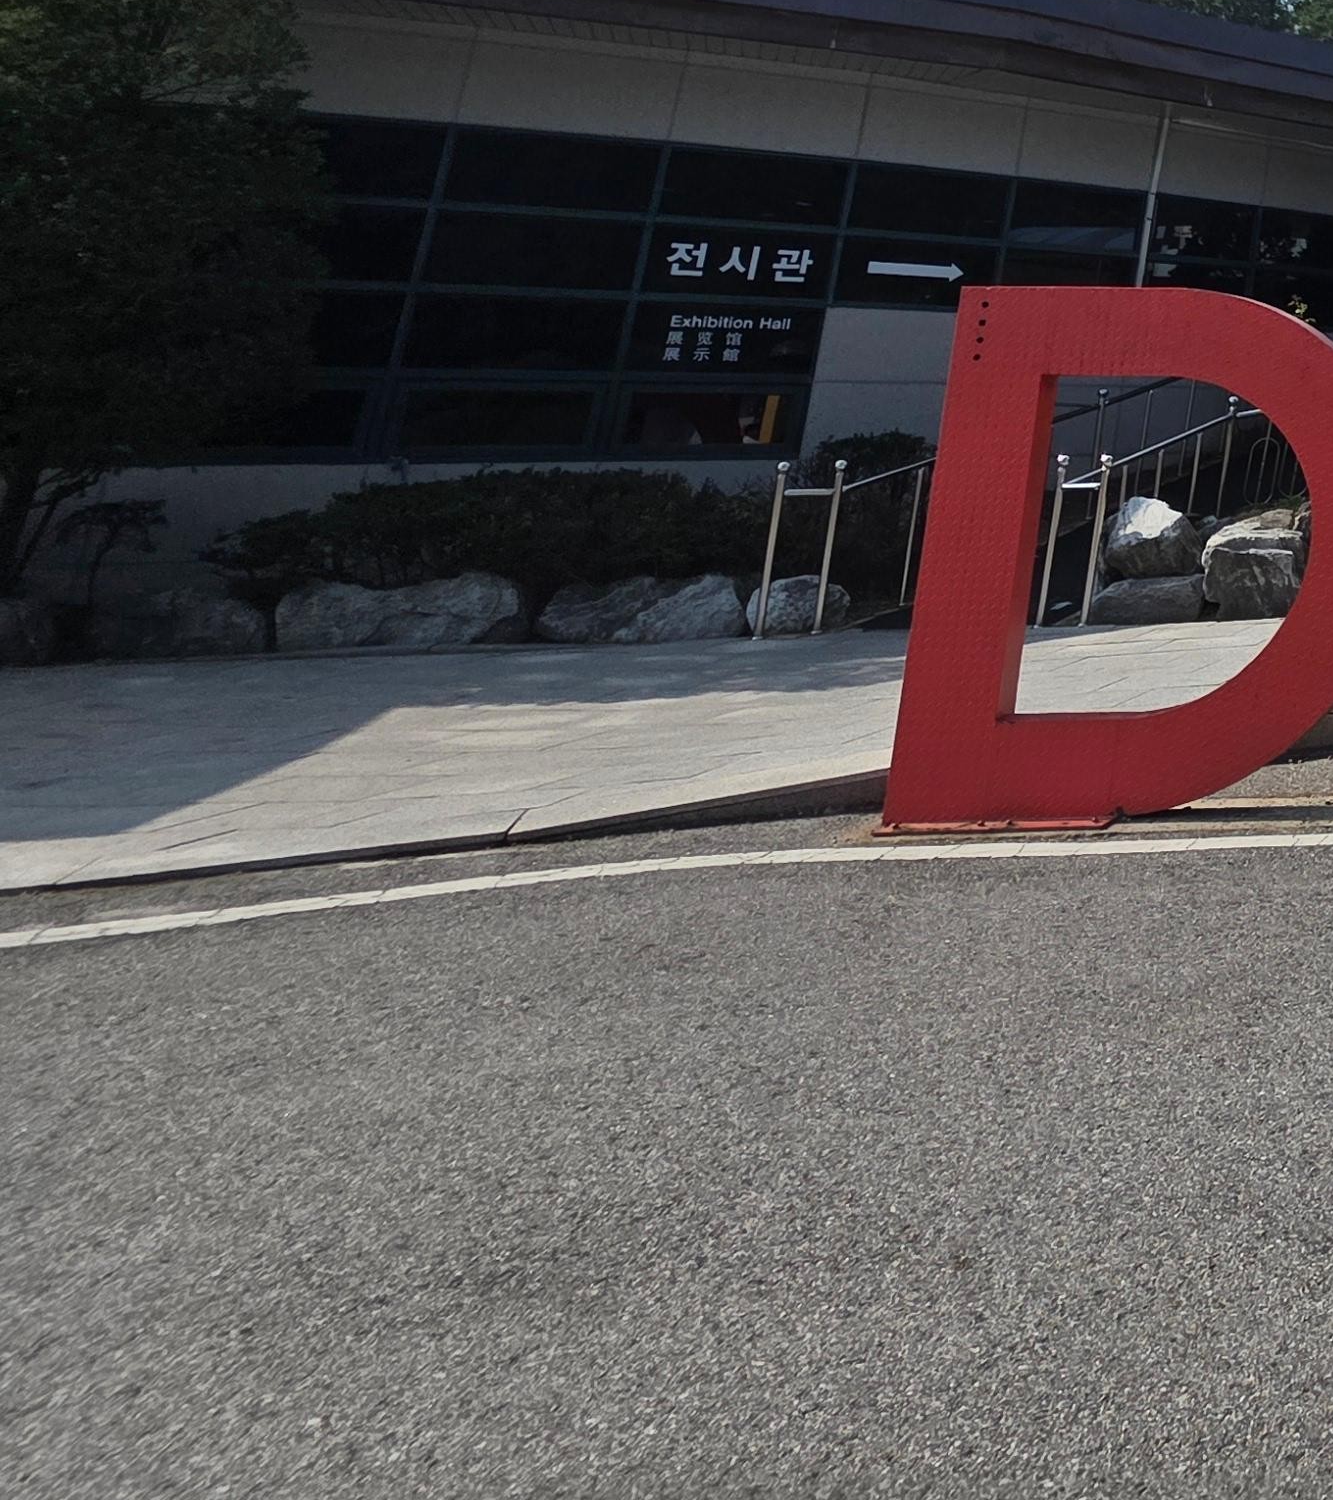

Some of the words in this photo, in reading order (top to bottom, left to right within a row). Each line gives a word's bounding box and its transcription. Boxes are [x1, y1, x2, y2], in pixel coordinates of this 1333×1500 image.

[666, 242, 814, 283] 전시관
[670, 315, 753, 330] Exhibition
[759, 317, 792, 331] Hall
